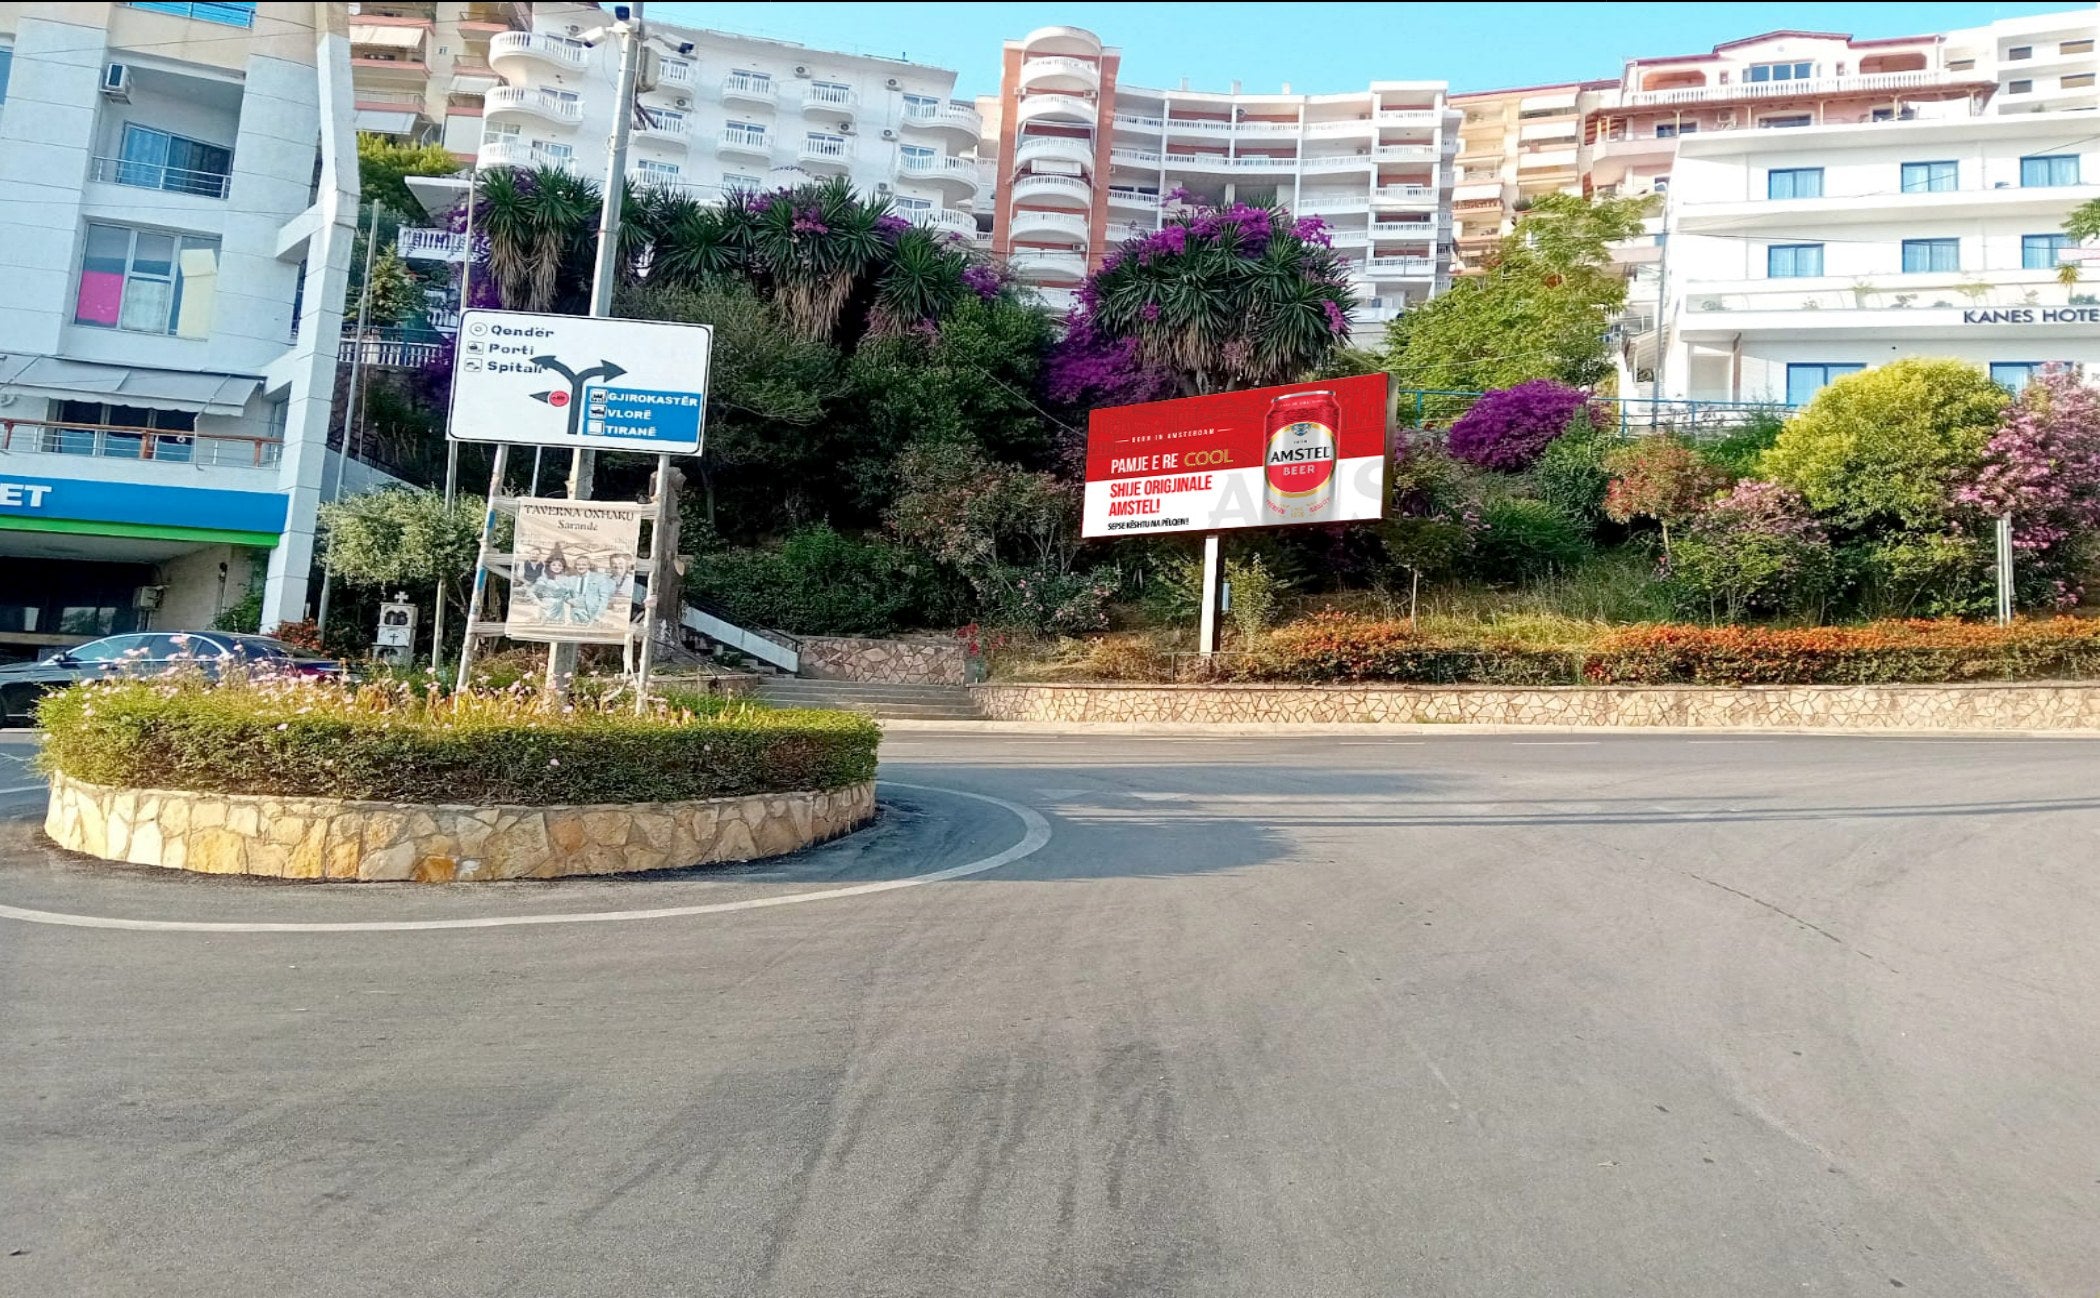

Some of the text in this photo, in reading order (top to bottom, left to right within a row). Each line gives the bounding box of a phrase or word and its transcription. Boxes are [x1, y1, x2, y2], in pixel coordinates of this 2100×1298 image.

[1963, 308, 2100, 324] KANES HOTE
[490, 324, 554, 338] Qendër
[489, 343, 534, 355] Porti
[608, 392, 698, 407] GJIROKASTËR
[607, 408, 652, 420] VLORË
[605, 425, 656, 437] TIRANË
[1111, 448, 1234, 474] PAMJE E RE COOL
[1270, 446, 1330, 462] AMSTEL
[1283, 464, 1315, 476] BEER
[1110, 475, 1213, 498] SHIJE ORIGJINALE
[0, 483, 53, 508] ET
[524, 504, 582, 518] TAVERNA
[1108, 498, 1161, 516] AMSTEL!
